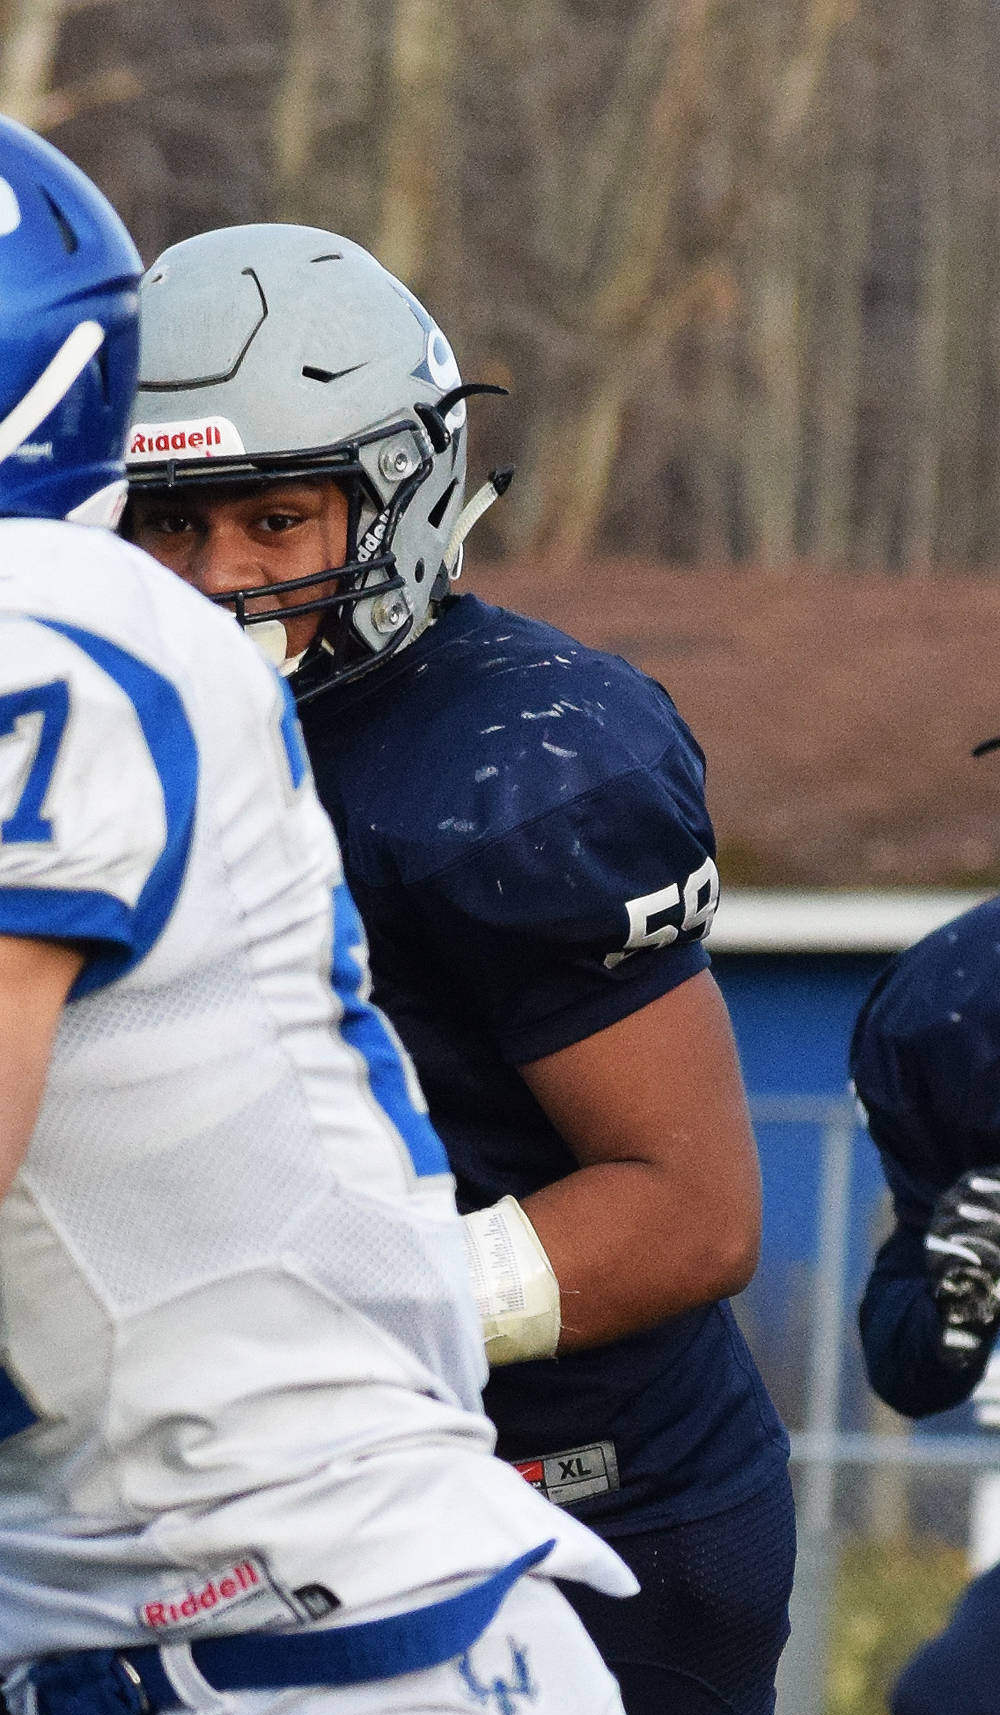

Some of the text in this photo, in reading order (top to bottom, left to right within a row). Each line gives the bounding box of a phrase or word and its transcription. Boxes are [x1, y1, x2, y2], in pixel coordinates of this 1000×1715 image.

[129, 425, 222, 454] Riddell
[558, 1457, 593, 1481] XL
[144, 1560, 259, 1628] Riddell
